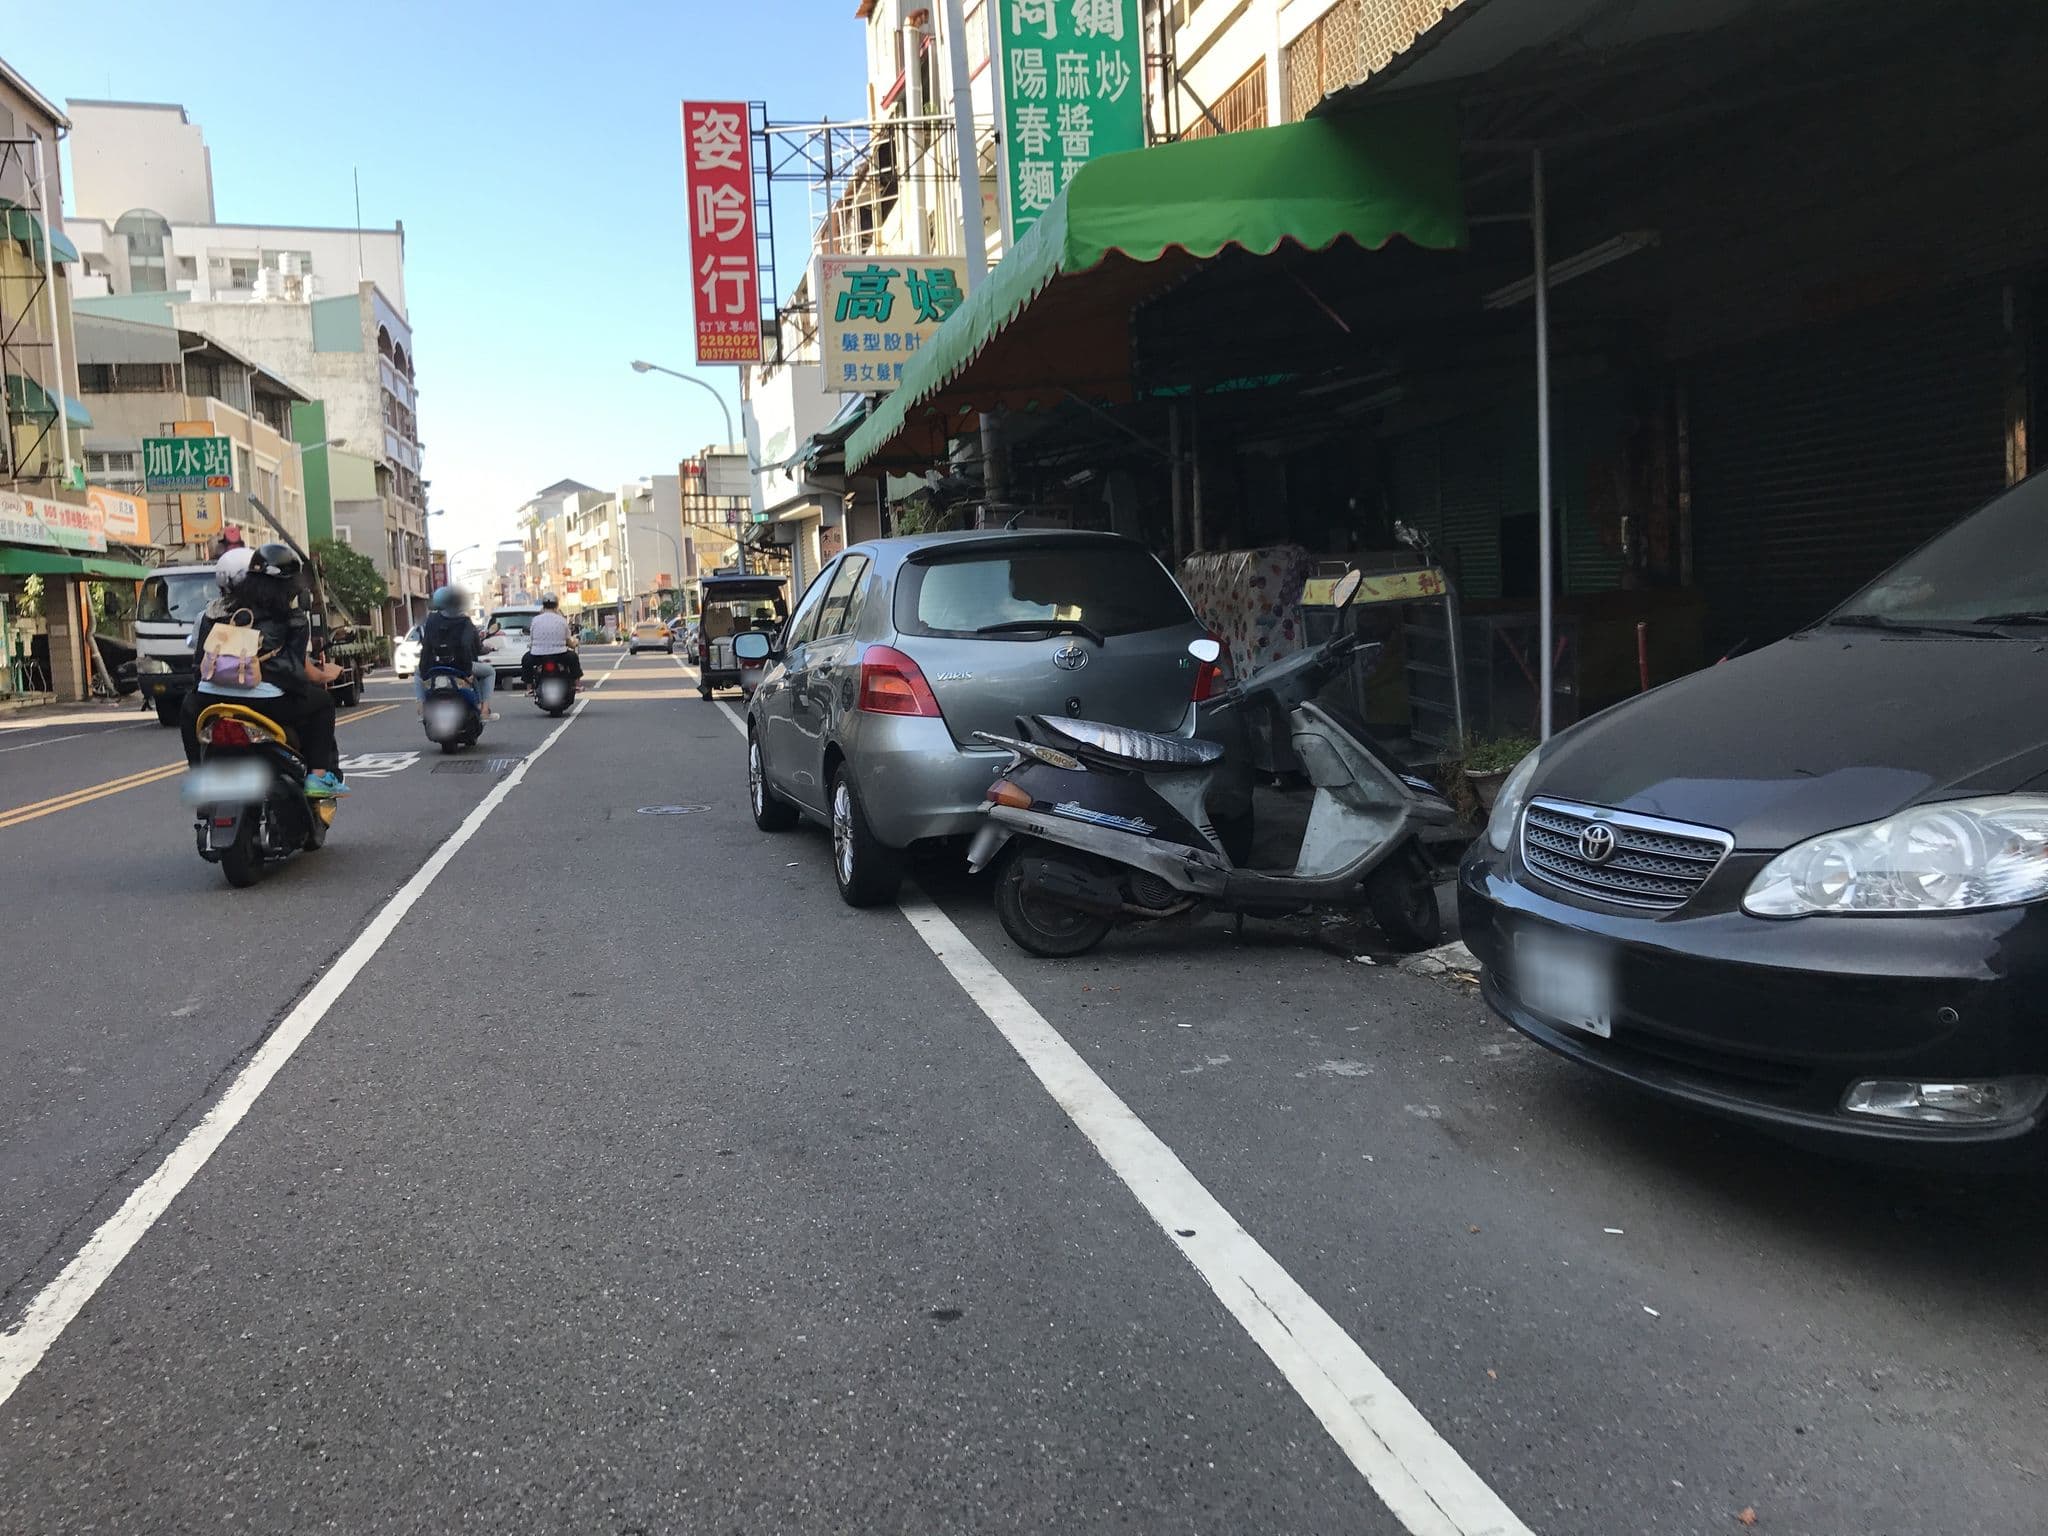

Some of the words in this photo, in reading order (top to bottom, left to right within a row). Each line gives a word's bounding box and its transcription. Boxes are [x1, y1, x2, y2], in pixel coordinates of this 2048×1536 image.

[1096, 50, 1131, 103] 炒
[691, 108, 750, 315] 姿吟行
[700, 334, 757, 346] 2282027
[842, 332, 921, 352] 髮型設計
[146, 440, 229, 475] 加水站
[936, 671, 972, 681] YARIS
